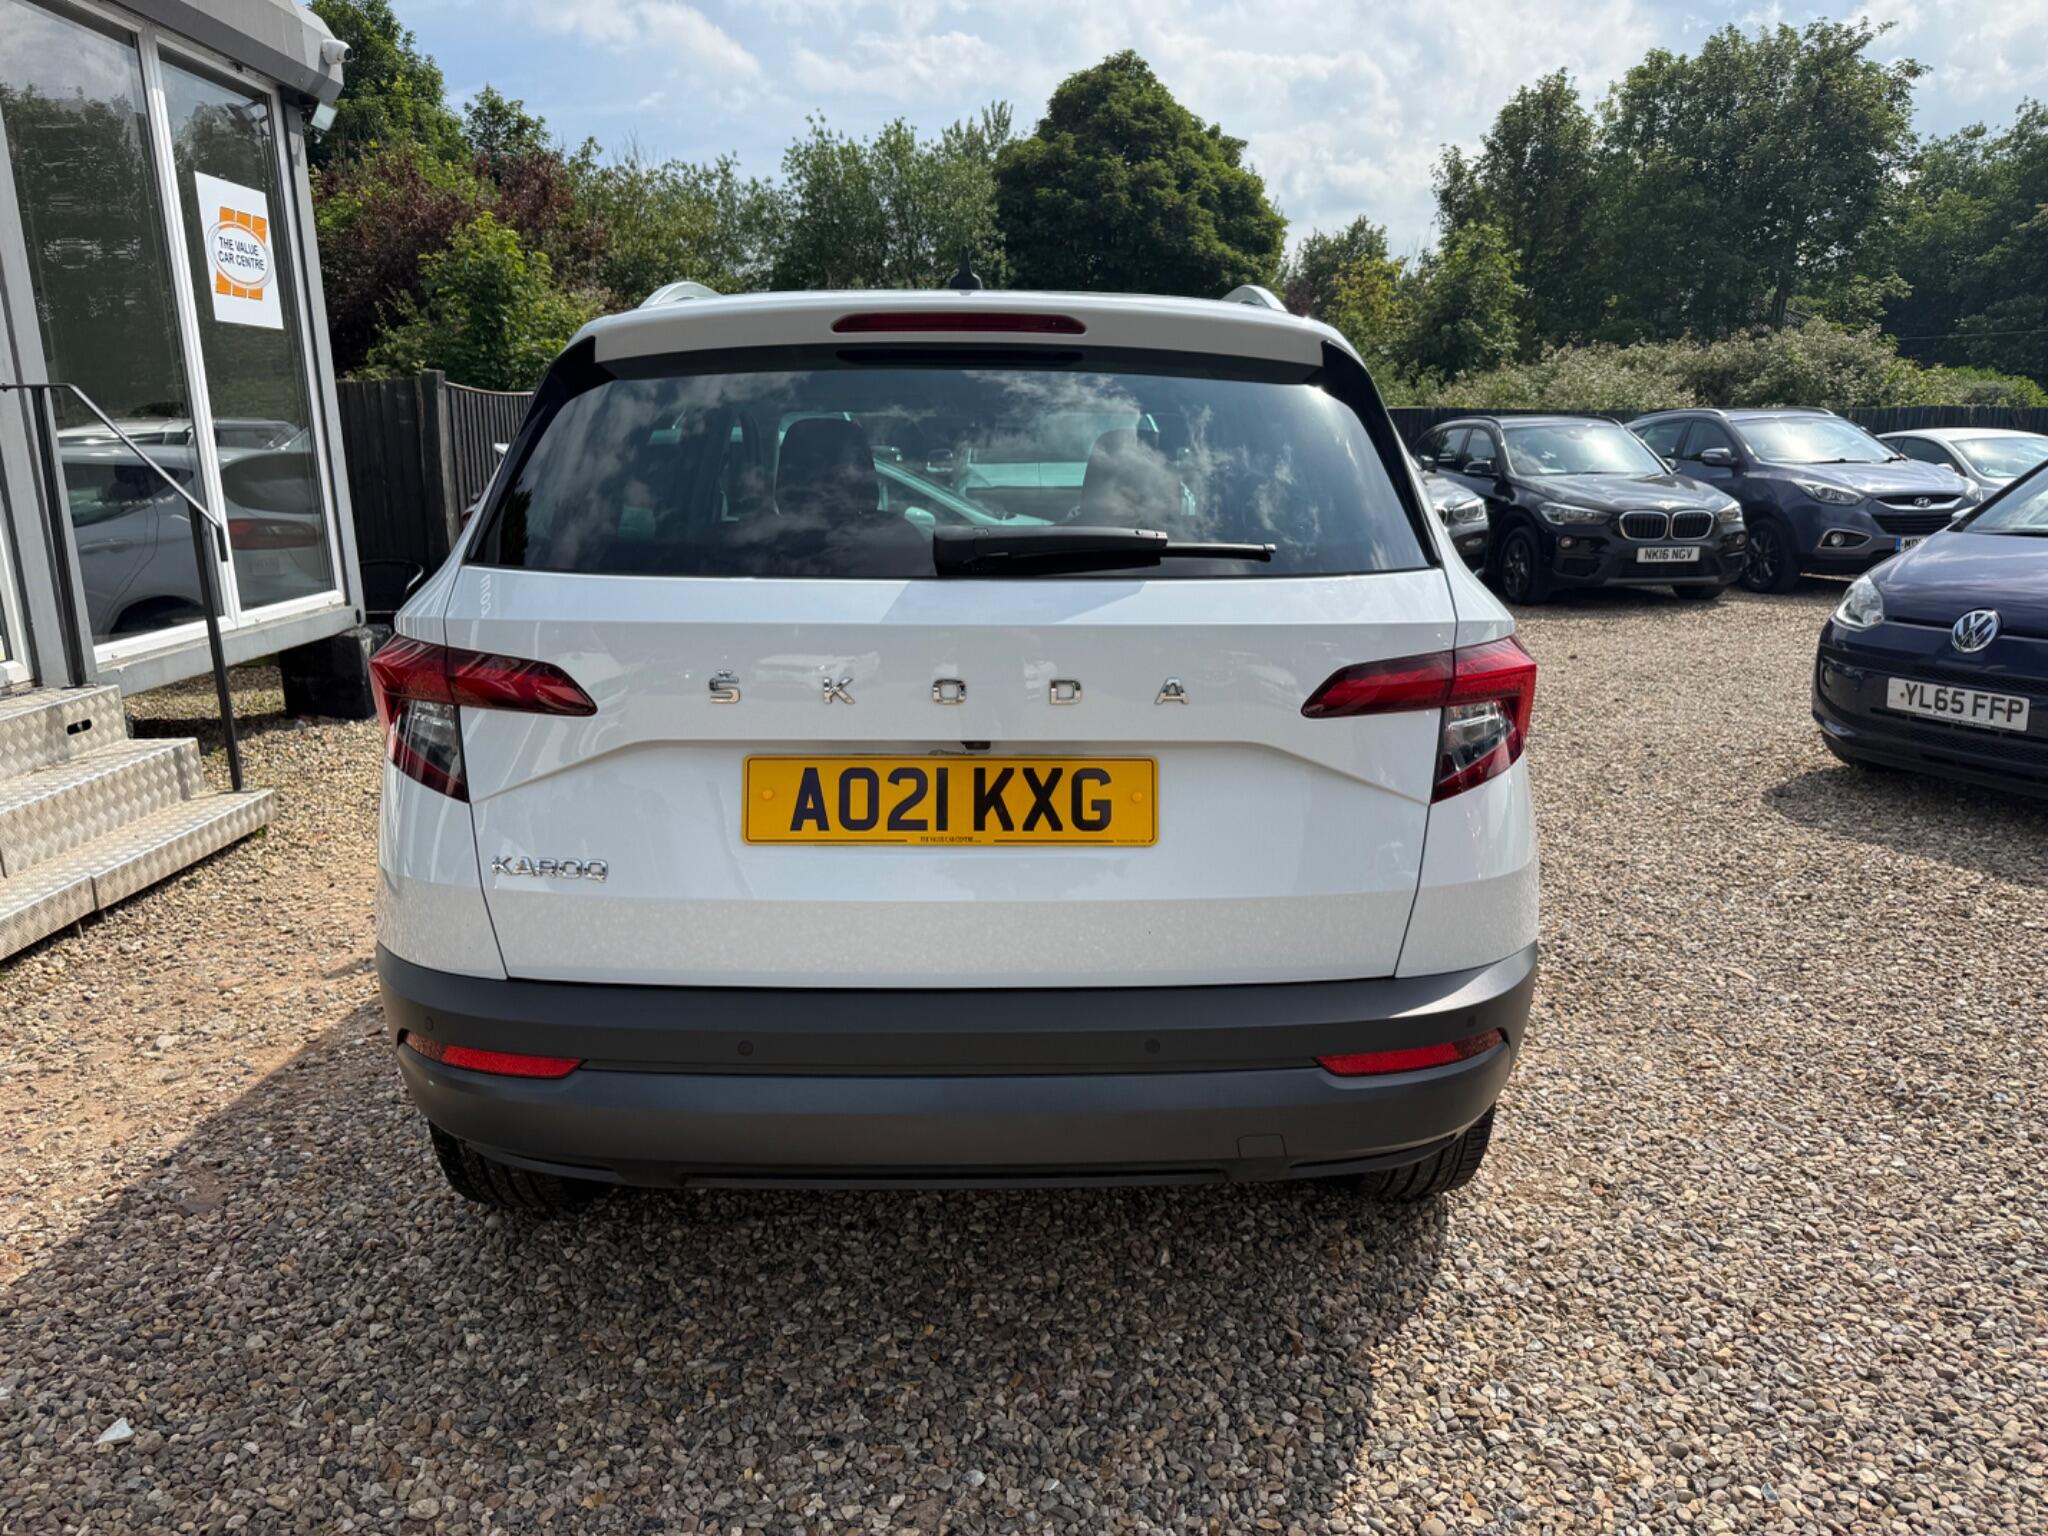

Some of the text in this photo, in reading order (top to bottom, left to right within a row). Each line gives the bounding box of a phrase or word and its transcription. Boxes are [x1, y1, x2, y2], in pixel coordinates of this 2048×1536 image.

[218, 236, 259, 256] THE VALUE
[218, 250, 265, 271] CAR CENTRE
[1905, 683, 1965, 714] YL65
[1971, 693, 2024, 723] FFP
[789, 767, 1113, 832] AO21 KXG
[491, 855, 609, 883] KAROQ
